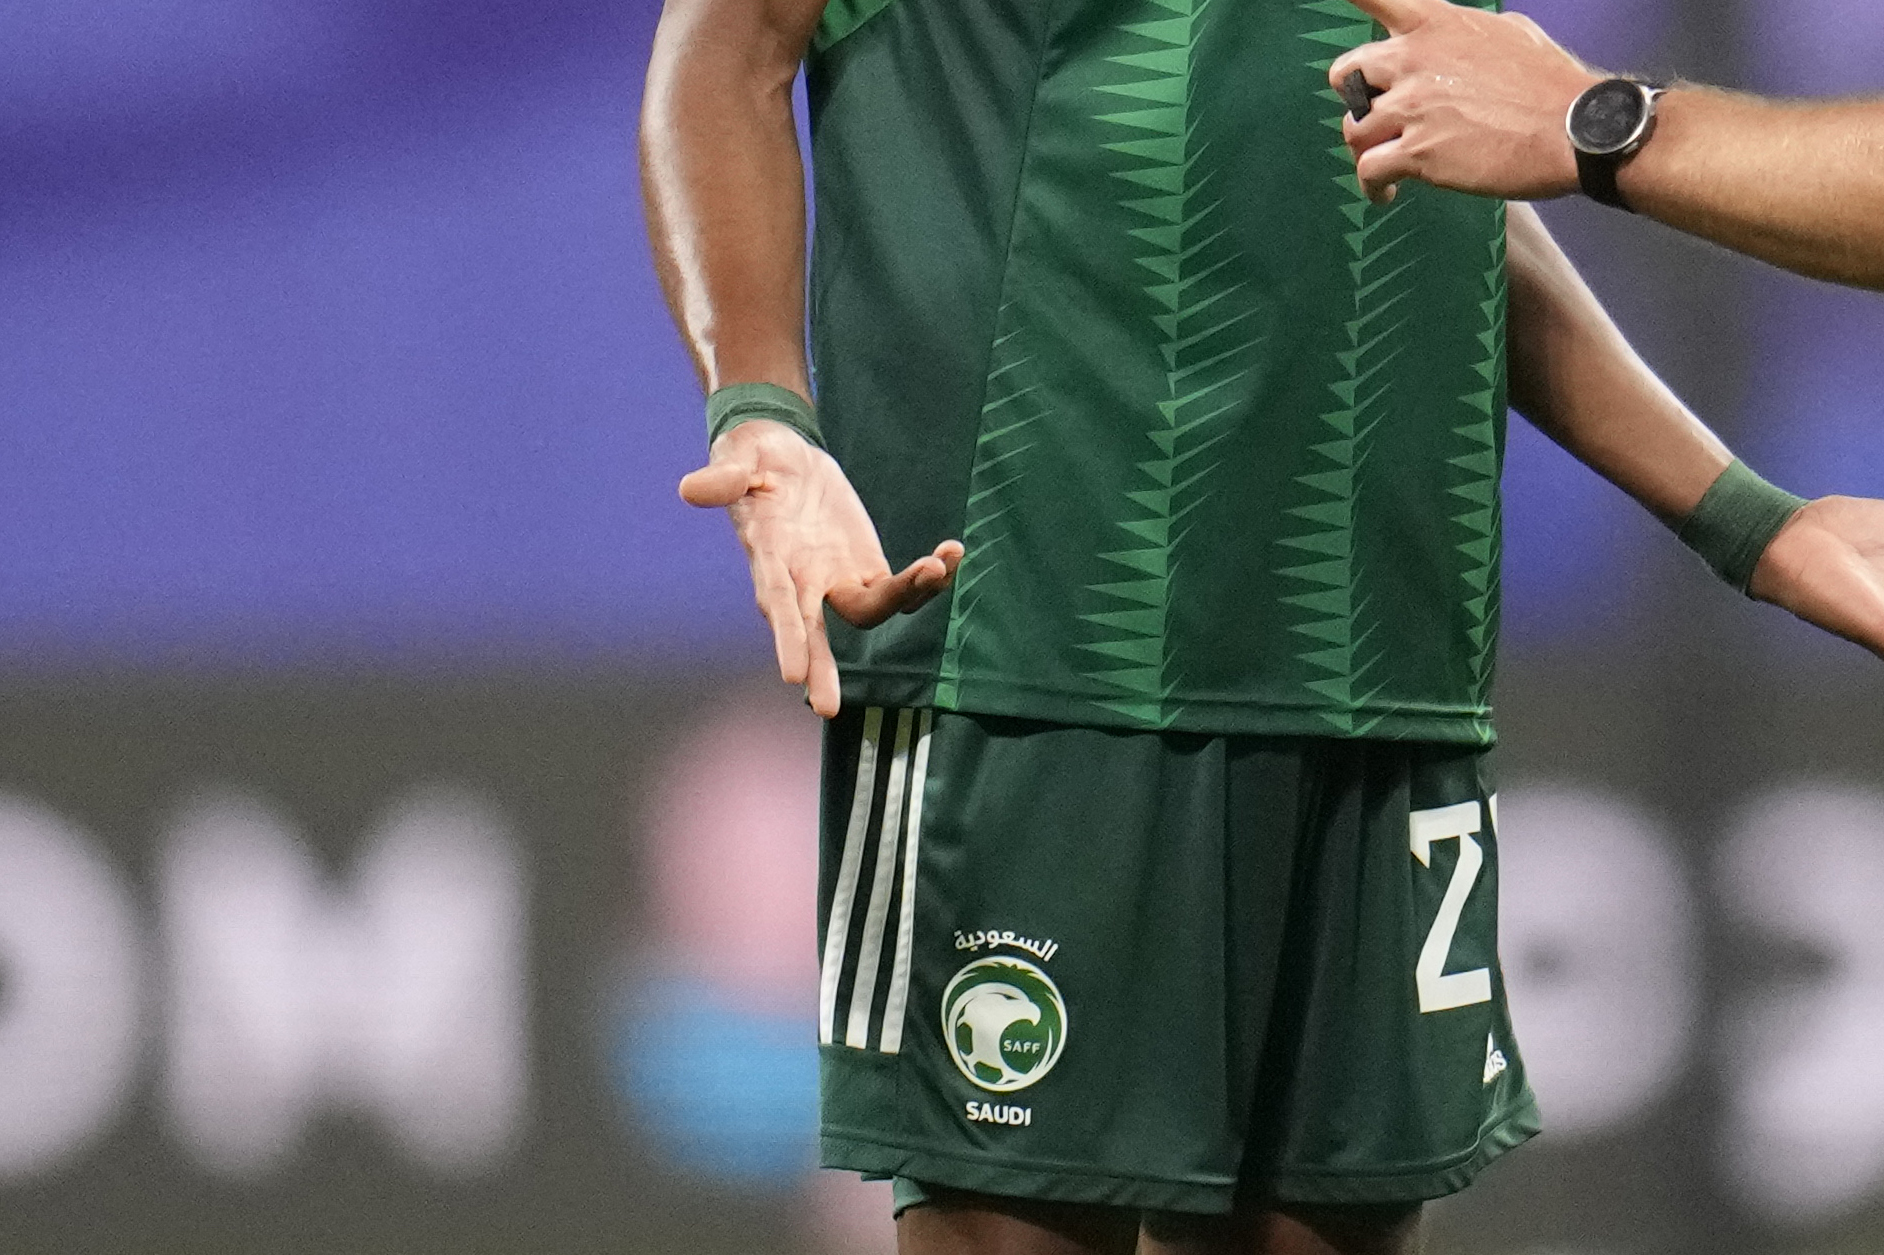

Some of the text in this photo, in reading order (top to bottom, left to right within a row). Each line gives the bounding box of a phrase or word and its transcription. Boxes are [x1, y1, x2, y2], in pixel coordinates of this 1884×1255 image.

[954, 929, 1059, 962] السعودية
[1003, 1039, 1041, 1054] SAFF
[966, 1101, 1032, 1126] SAUDI
